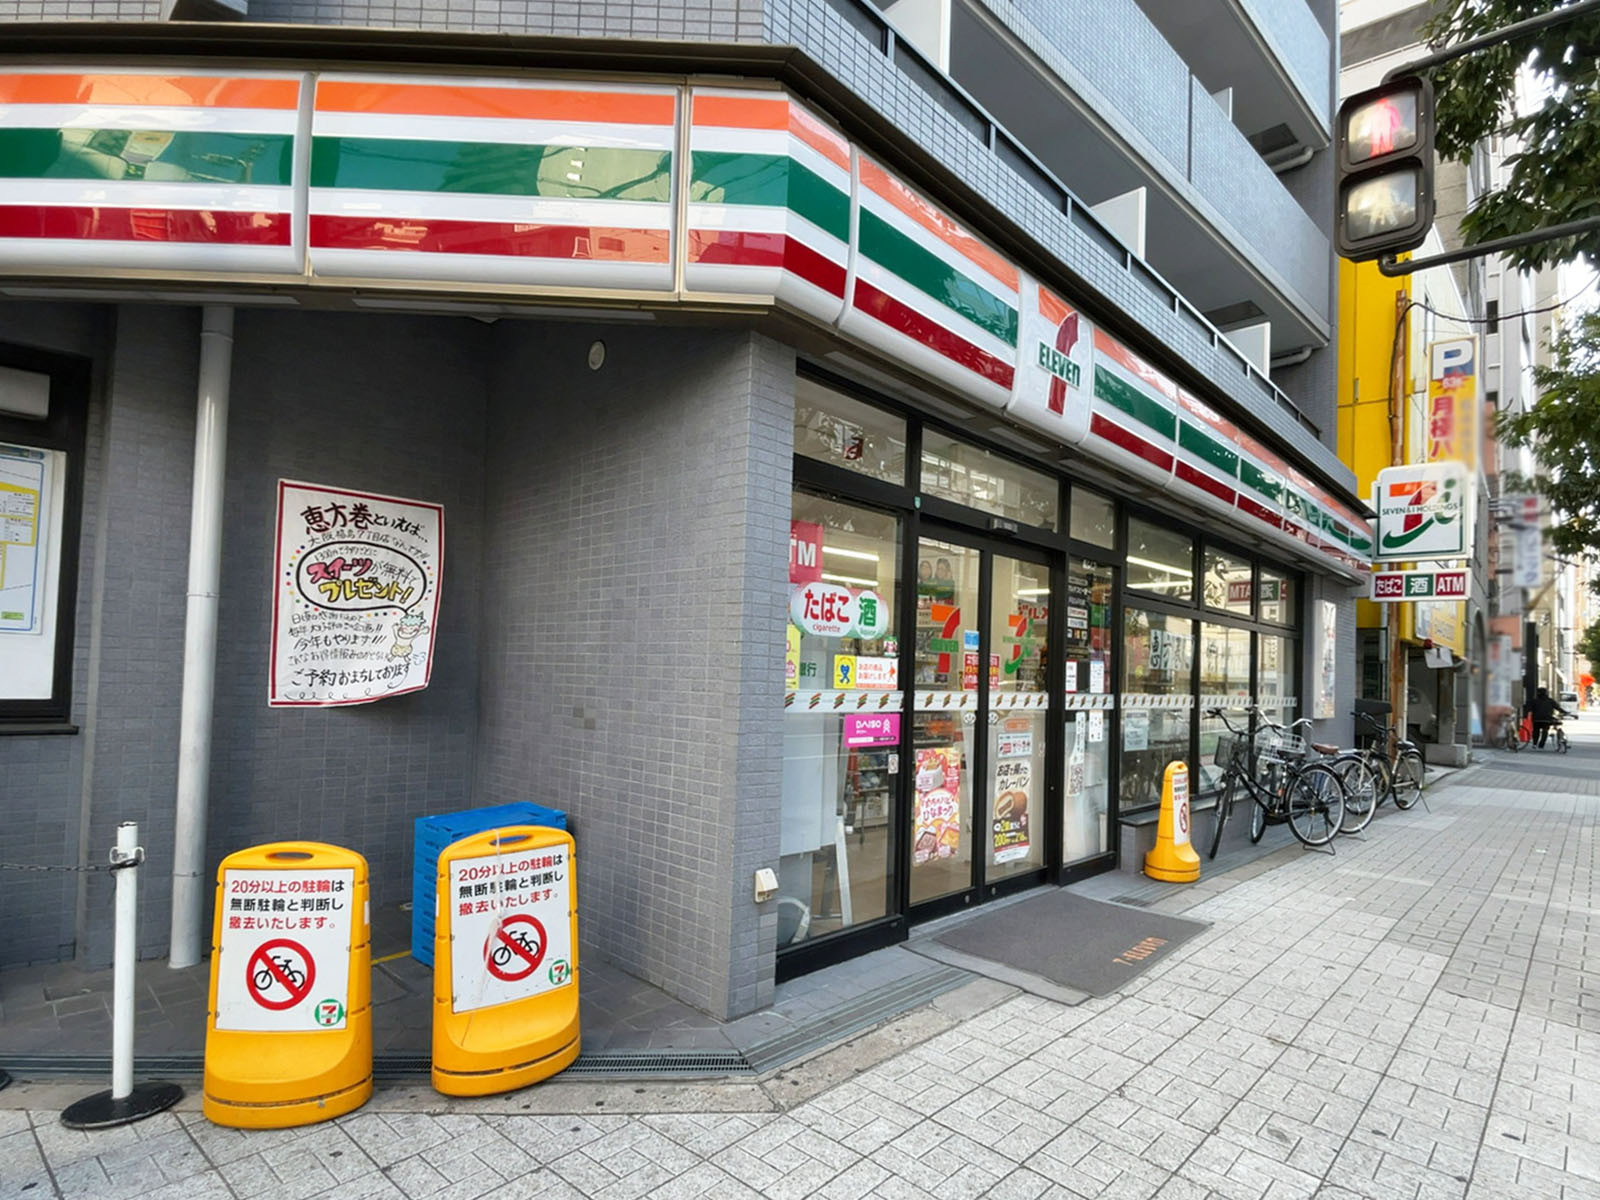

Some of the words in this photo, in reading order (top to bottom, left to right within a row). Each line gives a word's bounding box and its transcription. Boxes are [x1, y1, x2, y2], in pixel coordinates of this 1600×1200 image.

[1432, 341, 1473, 380] P
[1376, 579, 1402, 594] たばこ
[1410, 577, 1428, 594] 酒
[1437, 576, 1463, 592] ATM
[804, 589, 850, 622] たばこ
[858, 597, 877, 626] 酒
[855, 719, 882, 730] DAISO
[998, 776, 1031, 791] カレーパン
[231, 880, 345, 893] 20分以上の駐輪は
[230, 898, 344, 912] 無断駐輪と判断し
[229, 916, 336, 930] 撤去いたします。
